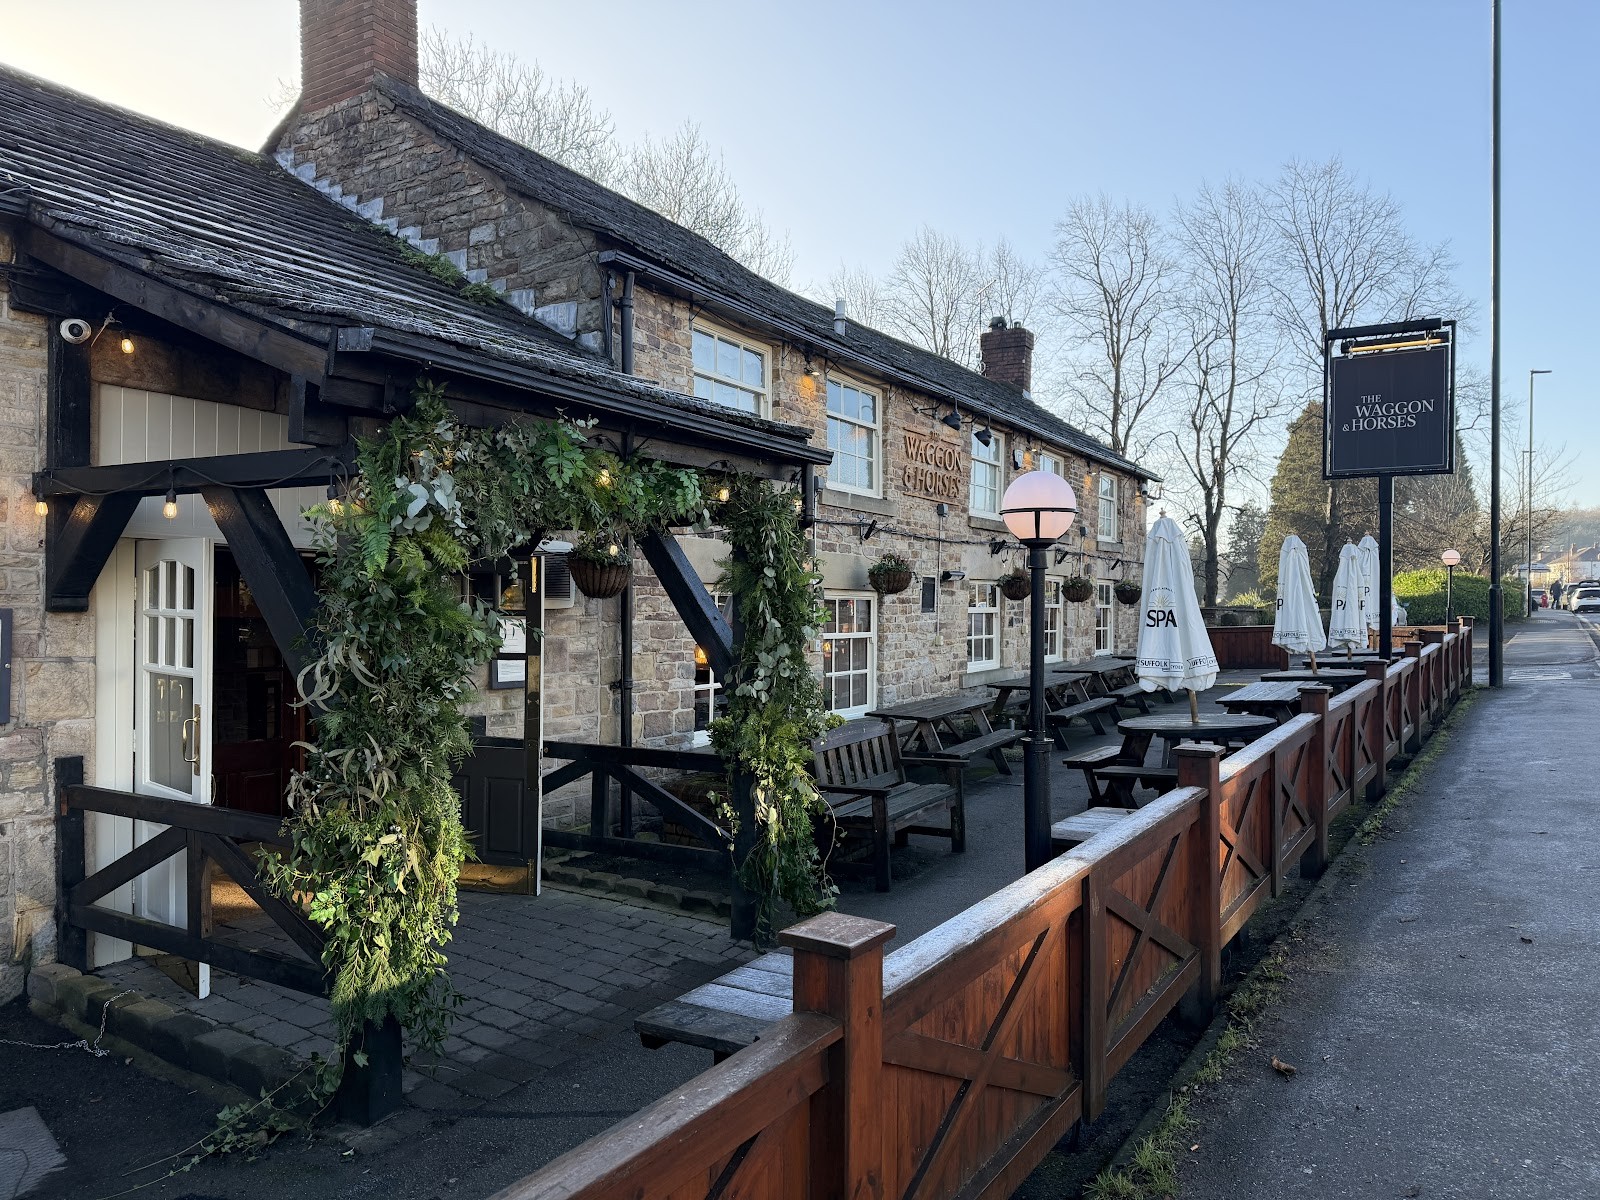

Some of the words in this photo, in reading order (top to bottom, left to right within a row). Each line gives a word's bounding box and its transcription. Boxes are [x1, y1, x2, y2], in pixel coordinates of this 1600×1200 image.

[1355, 399, 1435, 418] WAGGON
[1361, 394, 1382, 404] THE
[902, 435, 962, 473] WAGGON
[913, 466, 961, 498] HORSES
[1146, 608, 1178, 628] SPA
[1140, 659, 1169, 668] SUFFOLK
